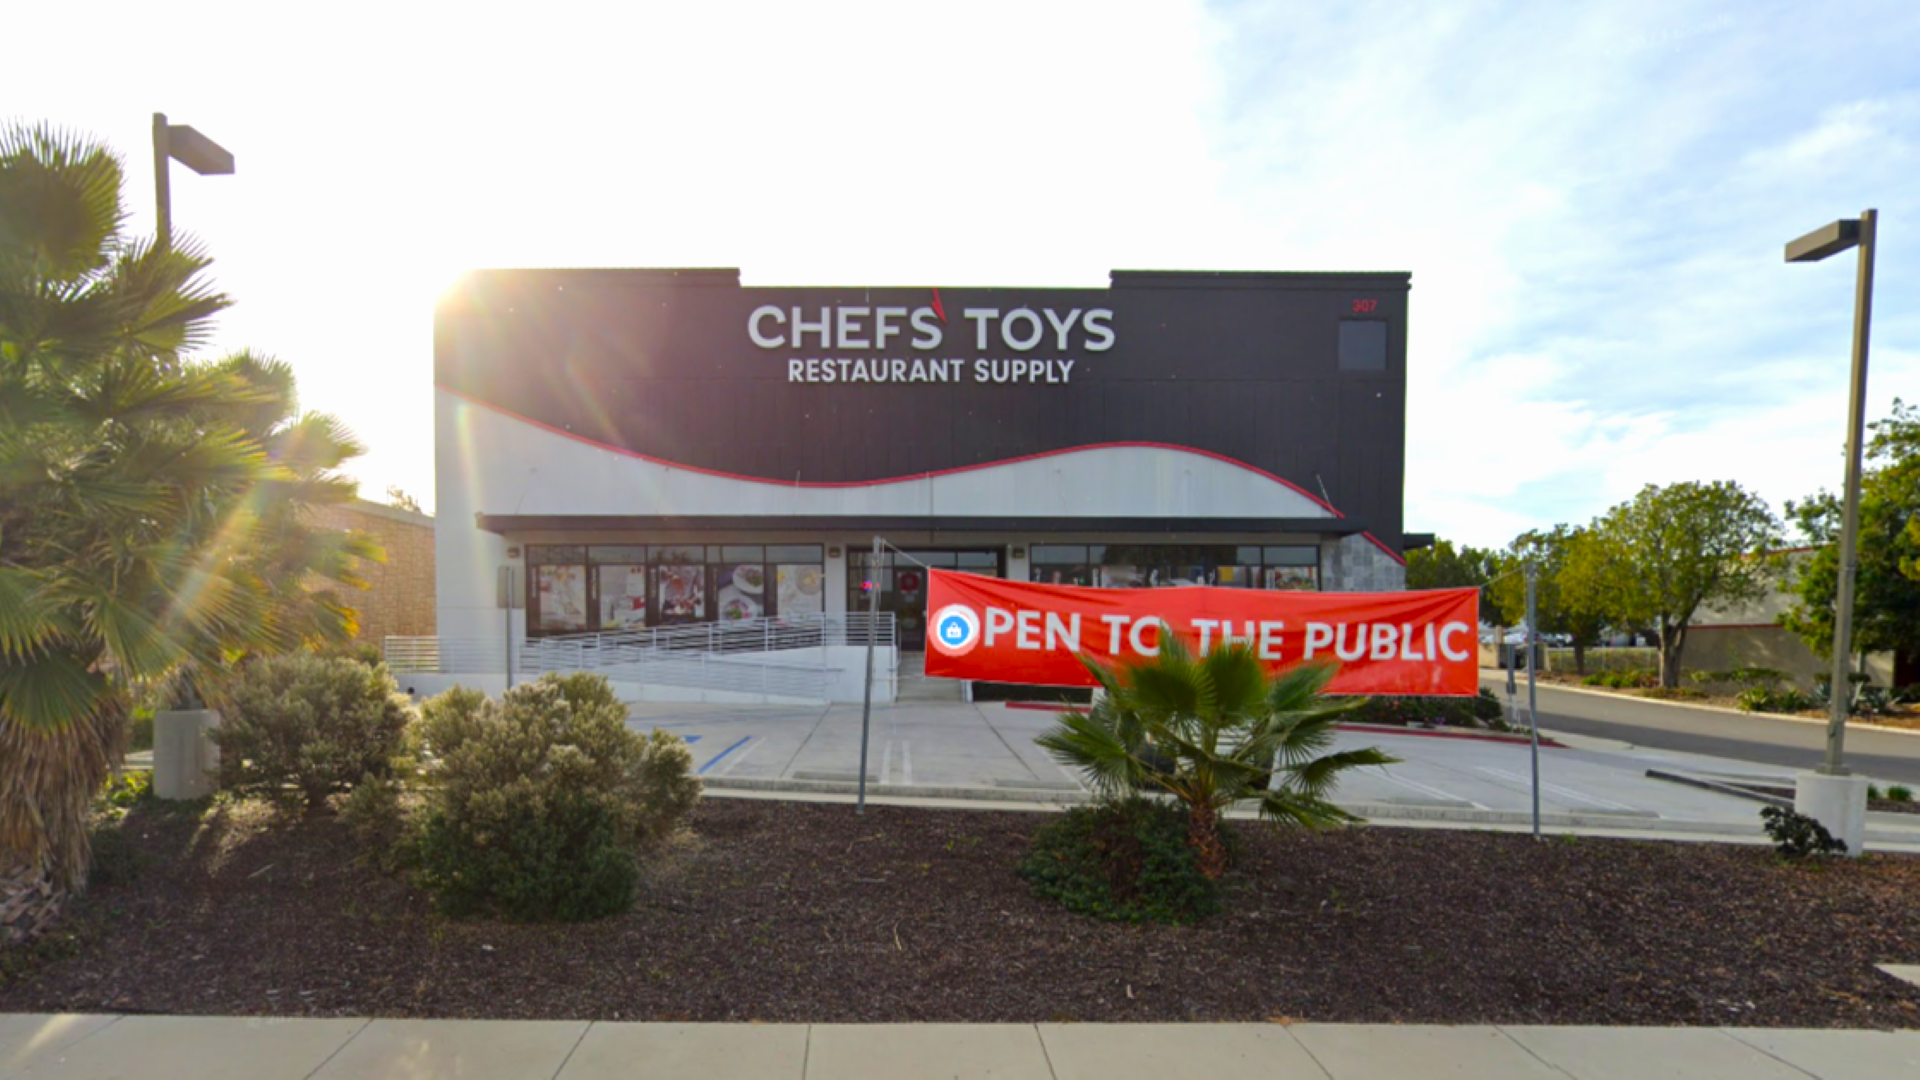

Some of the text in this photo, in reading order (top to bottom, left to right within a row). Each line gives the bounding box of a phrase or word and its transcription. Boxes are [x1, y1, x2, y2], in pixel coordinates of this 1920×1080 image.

[1352, 299, 1377, 313] 307
[963, 307, 1116, 351] TOYS
[788, 358, 1075, 383] RESTAURANT SUPPLY
[1191, 618, 1285, 660] THE
[1303, 621, 1470, 661] PUBLIC
